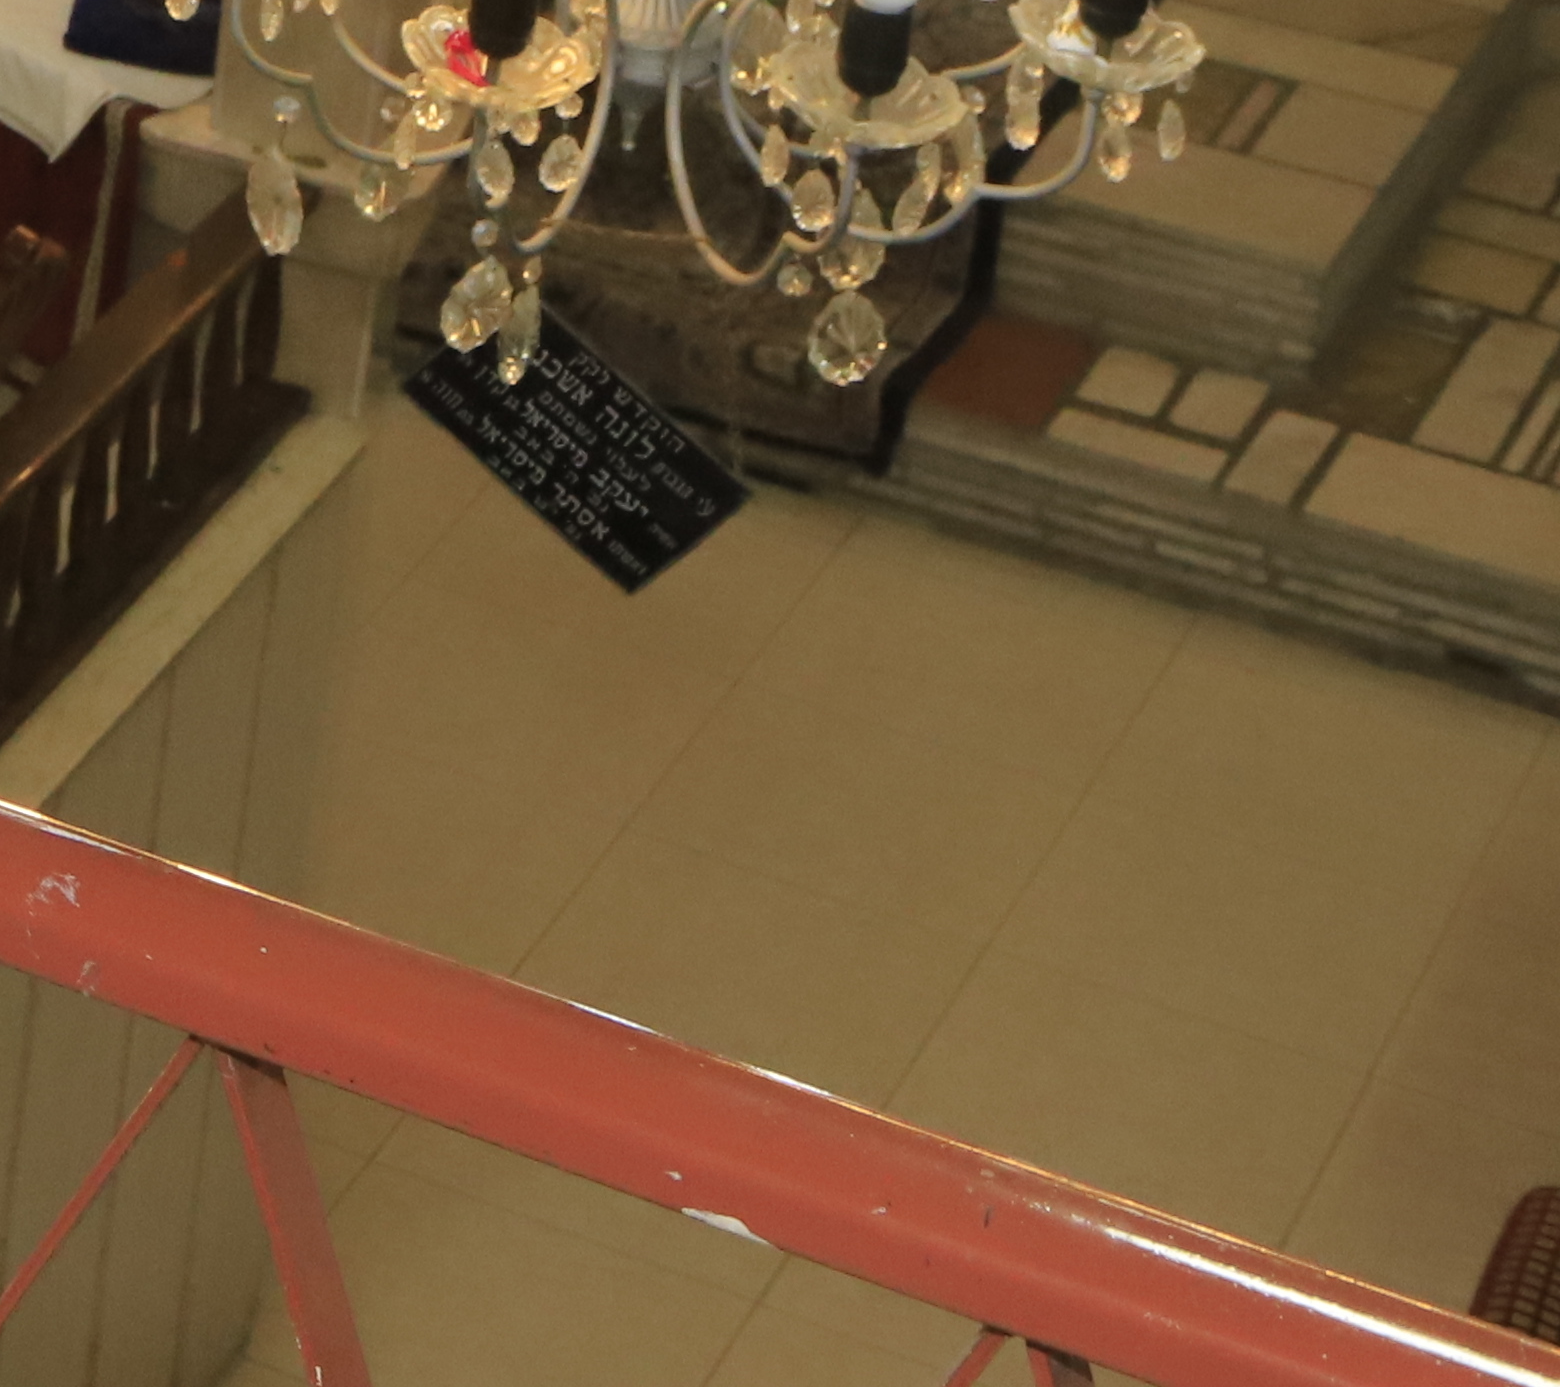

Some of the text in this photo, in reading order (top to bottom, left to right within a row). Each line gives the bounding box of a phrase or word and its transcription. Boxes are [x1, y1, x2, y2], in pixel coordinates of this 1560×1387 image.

[532, 349, 593, 407] אשכנ
[476, 412, 547, 486] מיסריאל
[522, 399, 589, 469] מיסריאל
[594, 404, 658, 460] לונה
[613, 389, 686, 453] הוקדש
[553, 481, 611, 541] אסתר
[590, 468, 650, 518] יעקב
